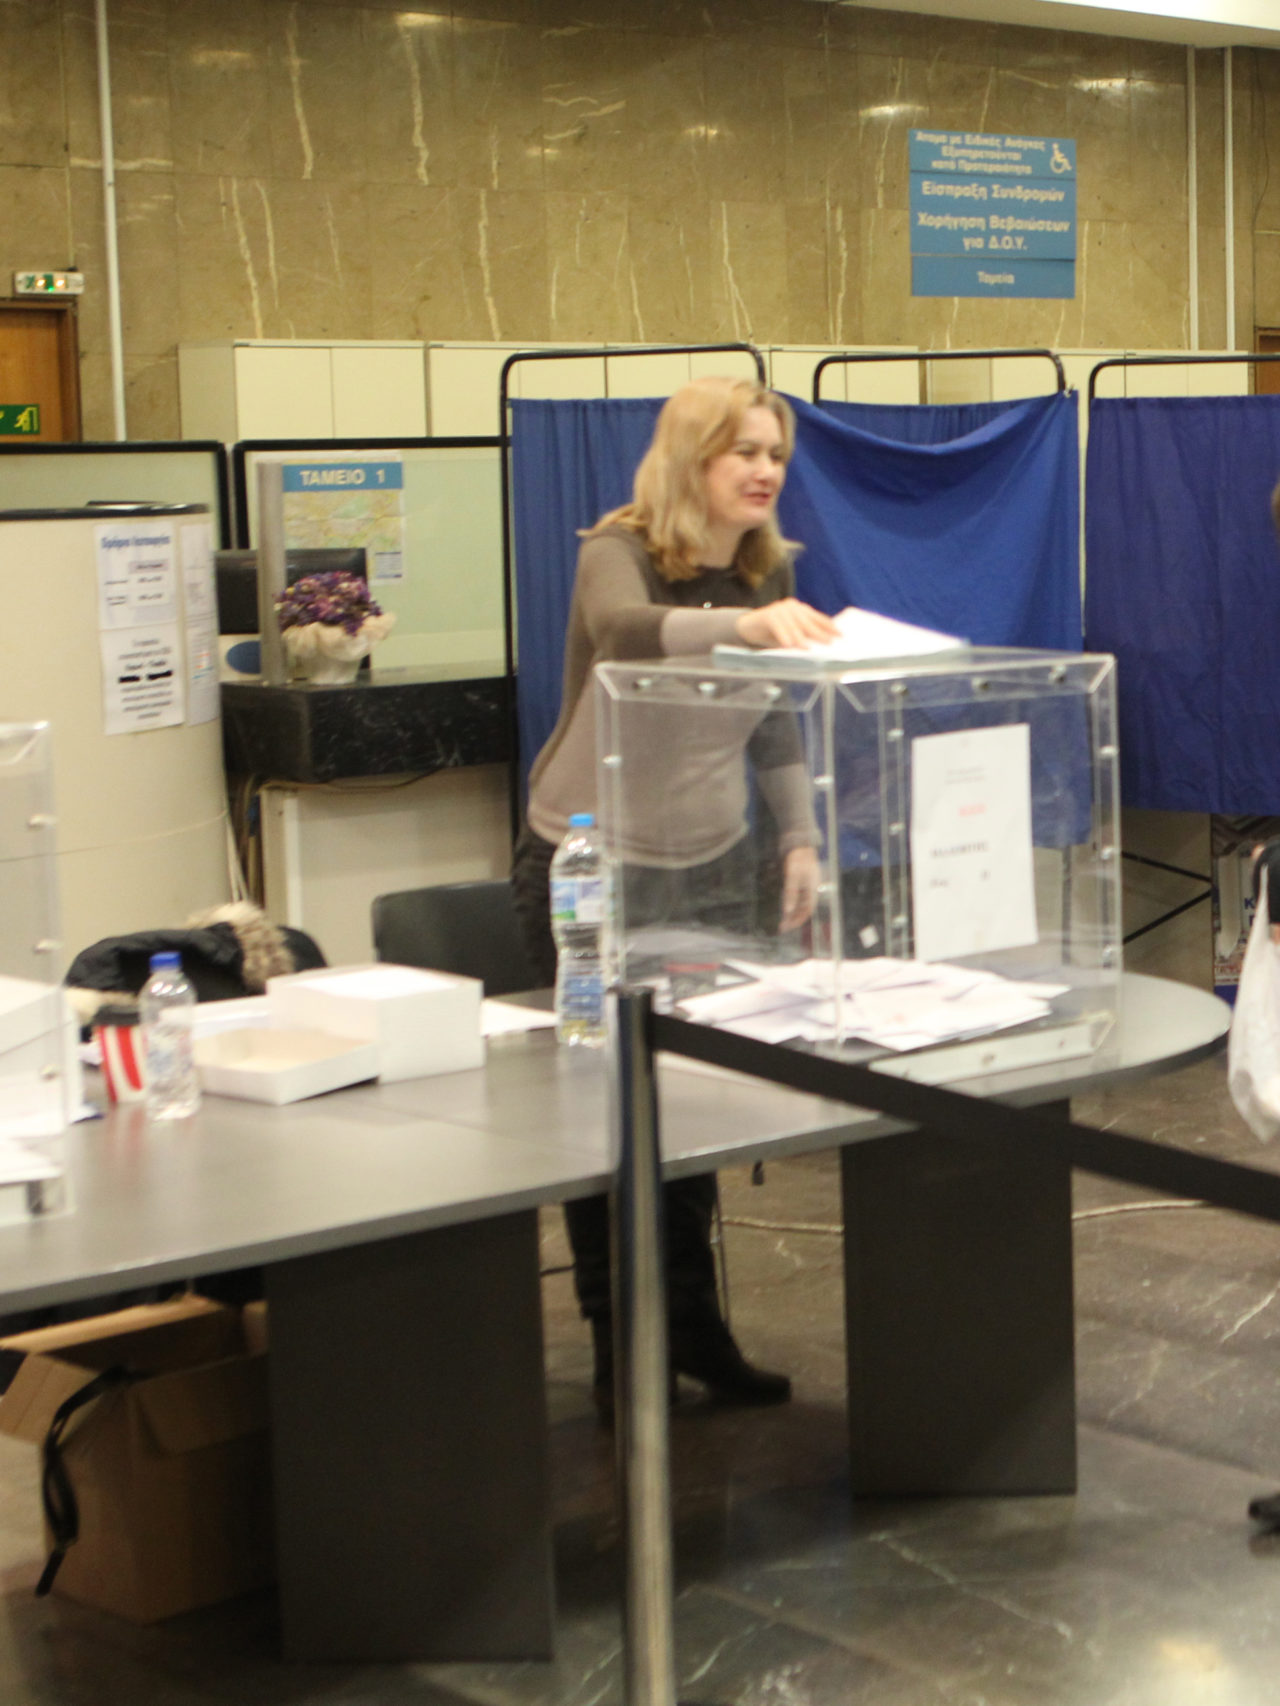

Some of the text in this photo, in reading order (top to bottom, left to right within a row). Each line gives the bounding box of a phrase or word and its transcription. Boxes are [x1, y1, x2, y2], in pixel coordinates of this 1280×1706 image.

[992, 184, 1066, 202] Συνδρομών
[917, 212, 986, 231] Χορήγηση
[962, 237, 984, 251] για
[376, 469, 385, 484] 1
